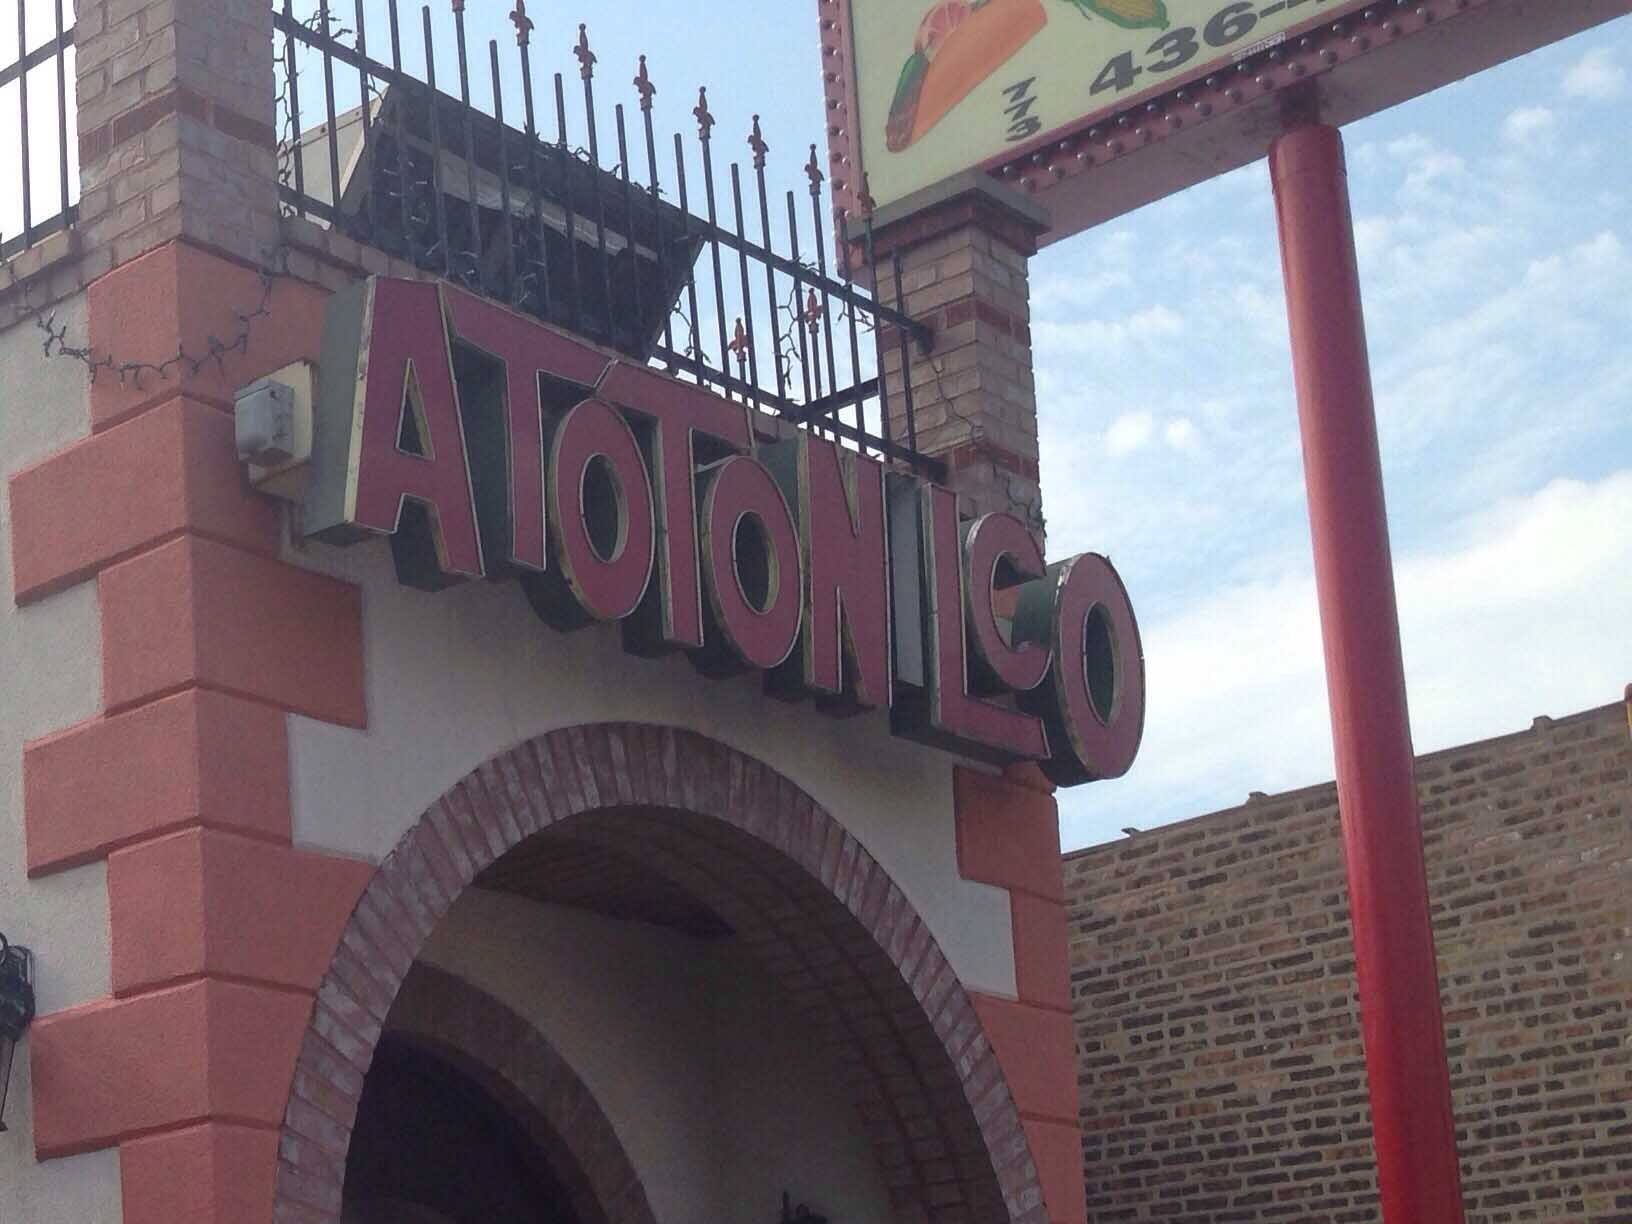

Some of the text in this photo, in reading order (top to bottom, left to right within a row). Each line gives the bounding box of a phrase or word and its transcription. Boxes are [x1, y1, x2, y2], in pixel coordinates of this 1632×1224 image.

[1001, 0, 1327, 143] 773 436-
[342, 275, 1148, 783] ATOTONILCO
